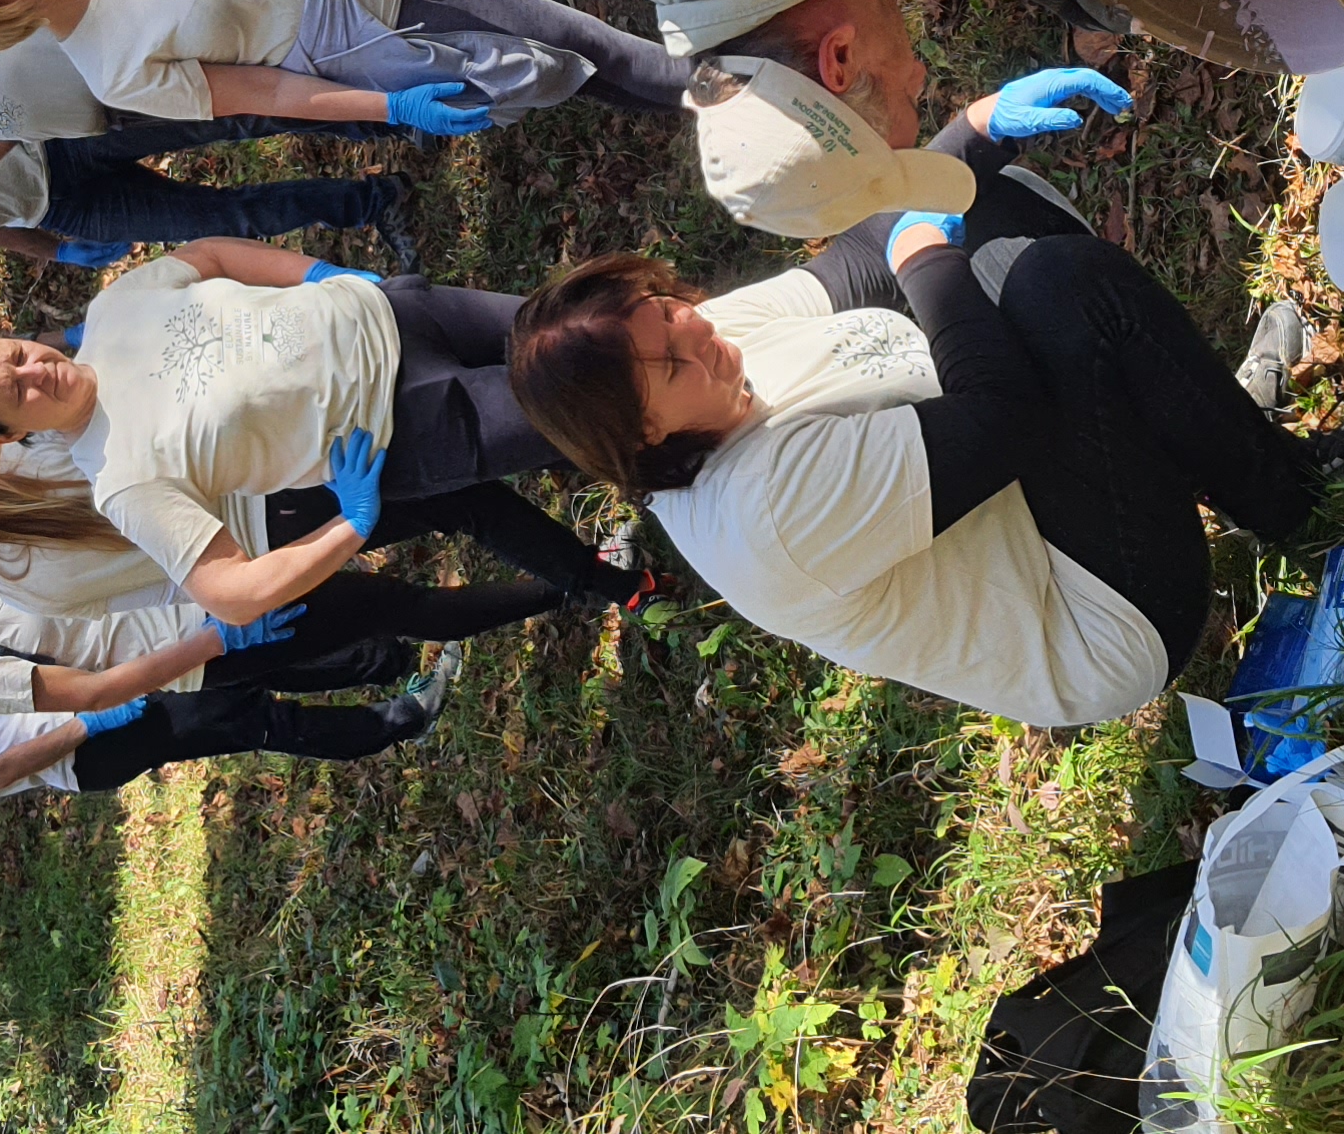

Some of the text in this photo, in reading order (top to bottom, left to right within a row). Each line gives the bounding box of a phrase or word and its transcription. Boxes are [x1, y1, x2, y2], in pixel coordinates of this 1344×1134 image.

[792, 98, 827, 126] GOZDOVE
[828, 124, 838, 136] ZA
[823, 140, 836, 152] 10
[244, 312, 252, 347] NATURE
